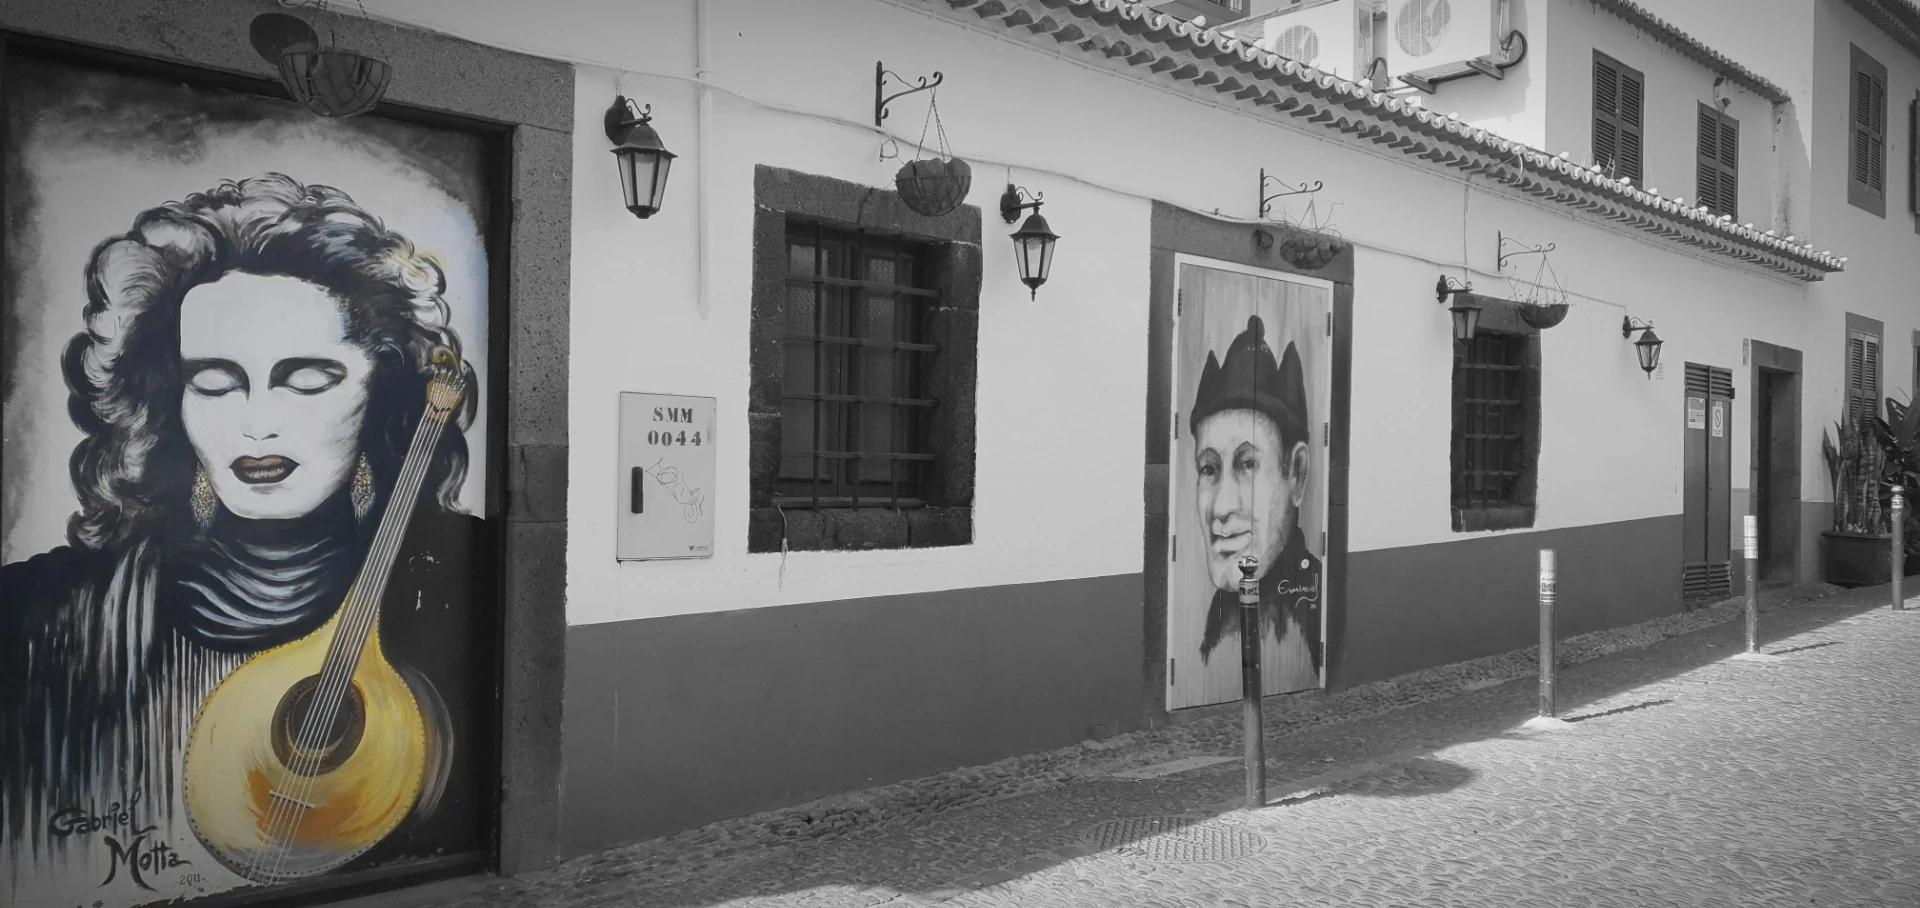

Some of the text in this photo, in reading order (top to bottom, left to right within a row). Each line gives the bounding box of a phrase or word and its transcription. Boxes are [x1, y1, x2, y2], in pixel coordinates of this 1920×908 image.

[653, 407, 693, 423] SMM
[647, 430, 702, 446] 0044
[50, 790, 158, 837] Gabriel
[99, 835, 192, 892] Motta
